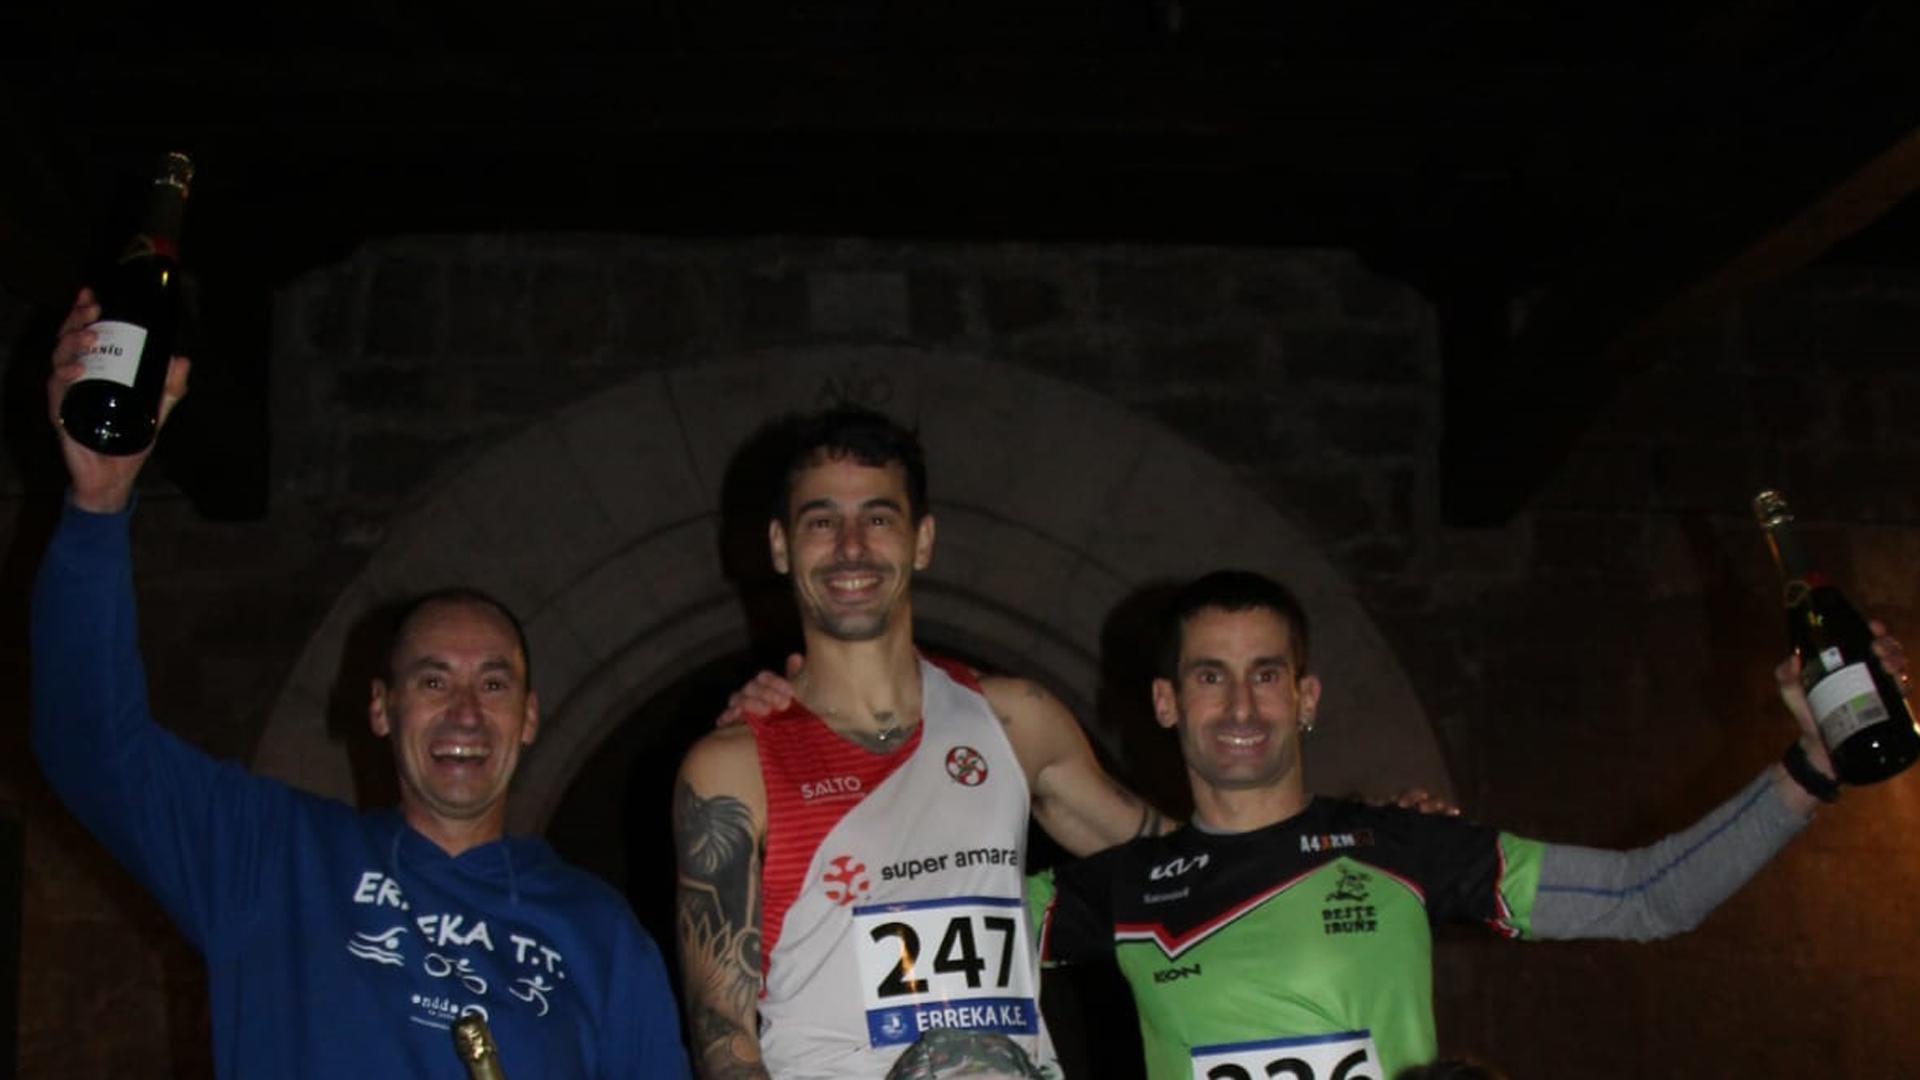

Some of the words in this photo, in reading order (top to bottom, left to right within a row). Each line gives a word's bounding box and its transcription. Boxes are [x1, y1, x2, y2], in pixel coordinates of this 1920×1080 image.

[801, 776, 862, 799] SALTO
[882, 854, 948, 880] super
[510, 934, 566, 980] T.T.
[870, 916, 1015, 998] 247
[915, 1006, 998, 1032] ERREKA
